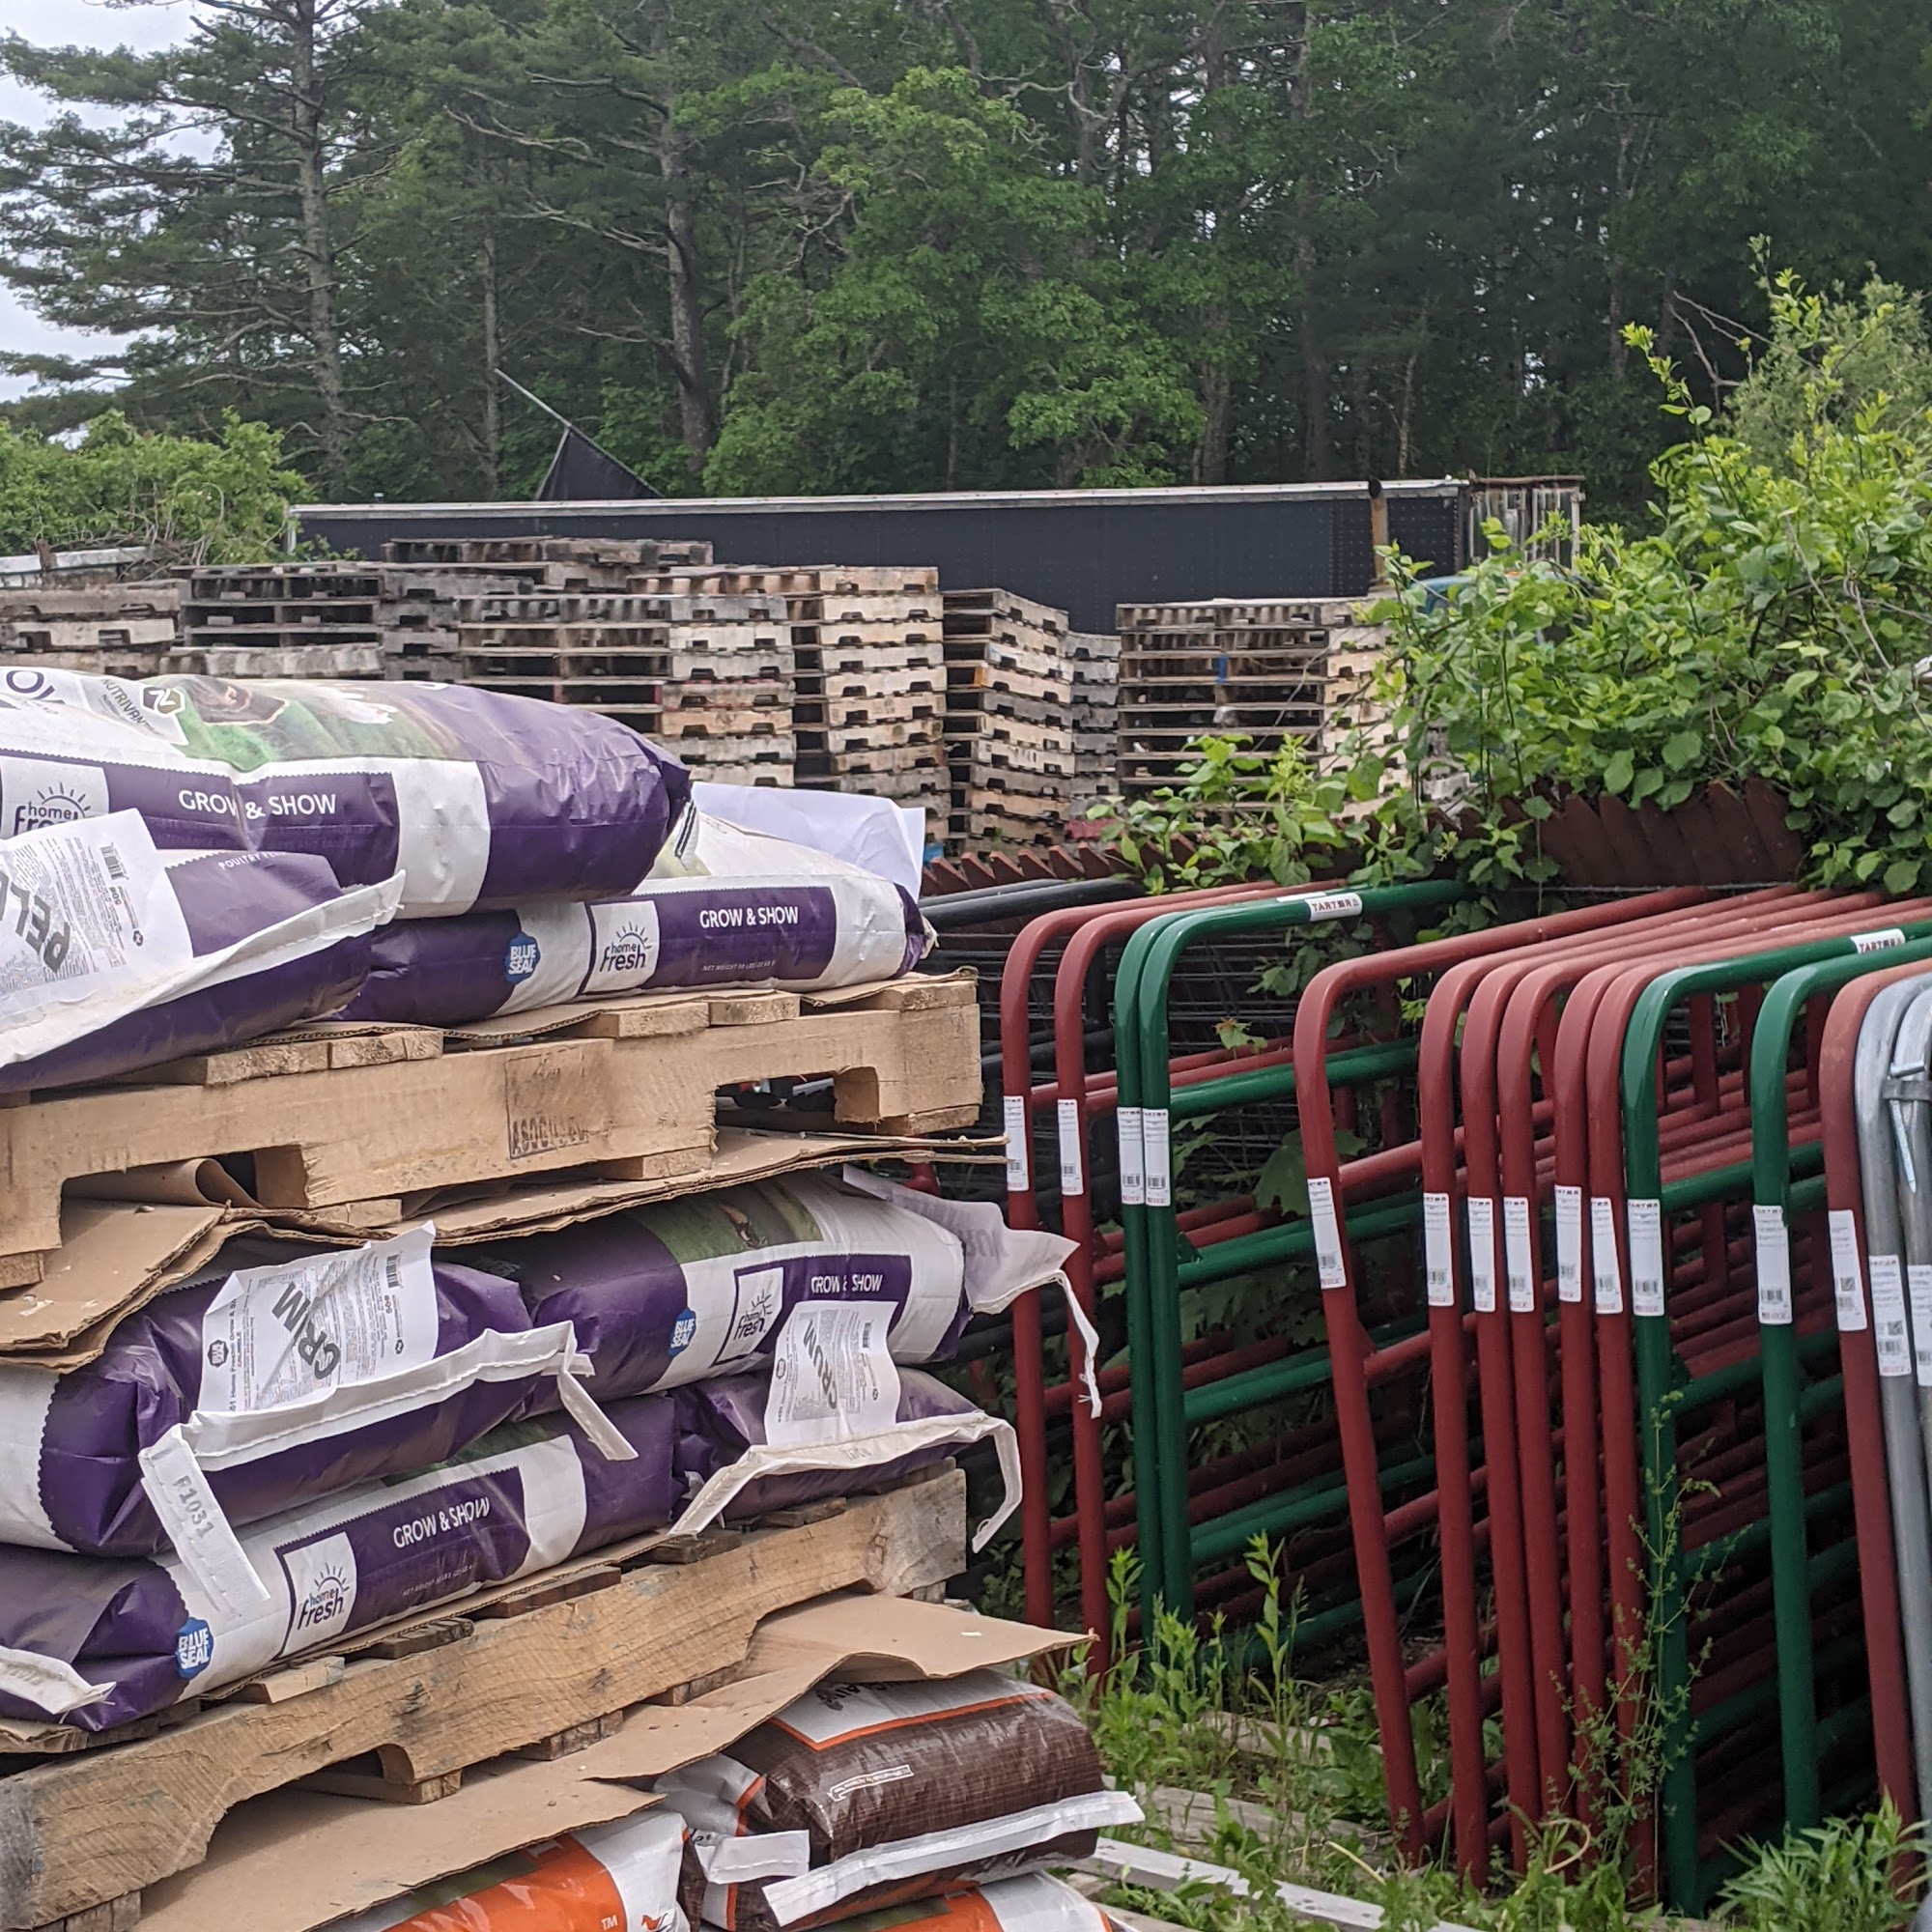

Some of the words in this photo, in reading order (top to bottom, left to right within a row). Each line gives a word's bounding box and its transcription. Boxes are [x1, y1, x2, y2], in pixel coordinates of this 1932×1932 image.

[28, 802, 72, 819] home
[245, 801, 266, 820] &
[268, 793, 336, 815] SHOW
[699, 908, 743, 928] GROW
[746, 907, 757, 926] &
[757, 906, 799, 924] SHOW
[510, 944, 537, 959] BLUE
[599, 944, 646, 973] fresh
[611, 941, 638, 954] home
[508, 957, 536, 975] SEAL
[810, 1275, 840, 1293] GROW
[851, 1274, 883, 1293] SHOW
[392, 1514, 438, 1548] GROW
[439, 1511, 451, 1532] &
[448, 1496, 491, 1528] SHOW
[309, 1587, 336, 1607] home
[297, 1587, 344, 1631] fresh
[178, 1628, 211, 1654] BLUE
[180, 1644, 211, 1670] SEAL
